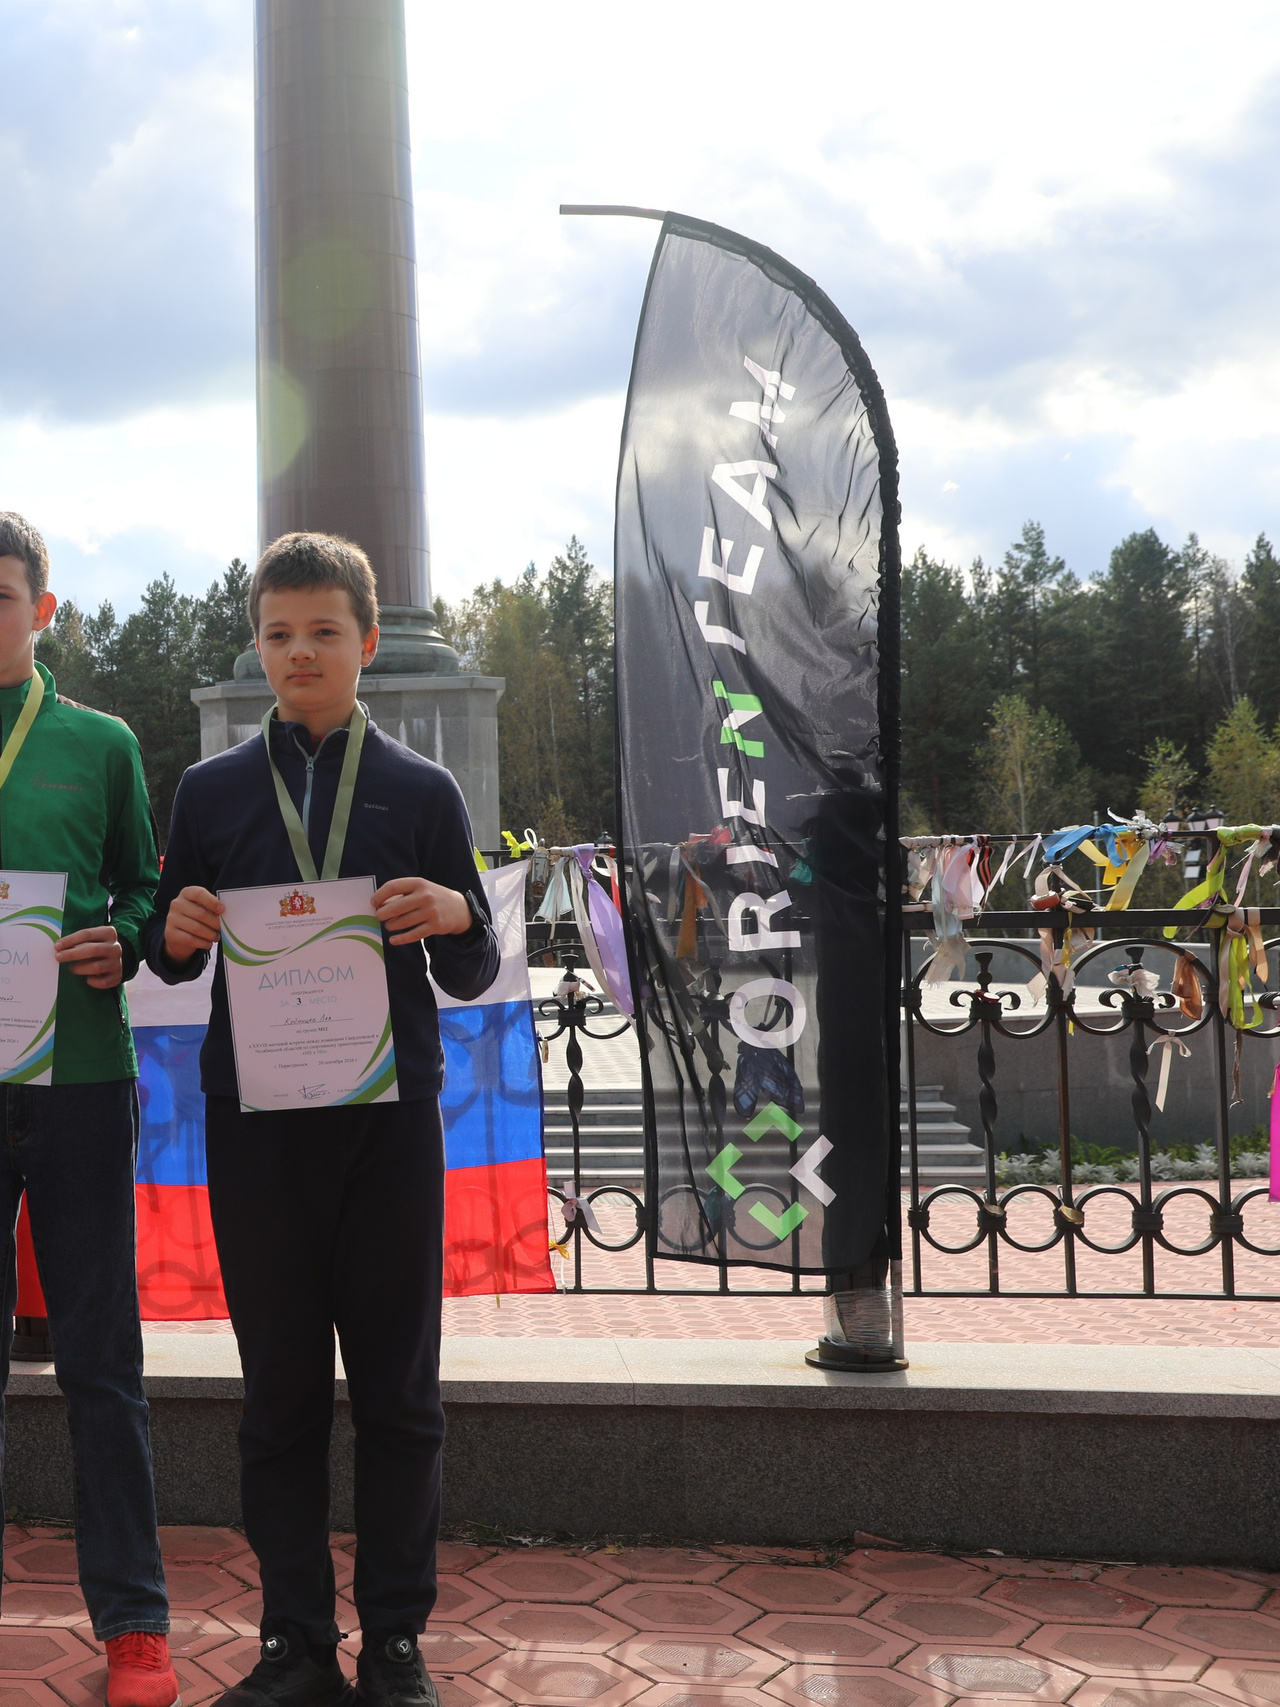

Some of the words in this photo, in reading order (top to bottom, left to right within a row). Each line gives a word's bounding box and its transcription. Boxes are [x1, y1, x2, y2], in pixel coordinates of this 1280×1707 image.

[694, 355, 807, 1049] ORIENTEAM
[258, 964, 355, 991] ДИПЛОМ
[296, 997, 302, 1006] 3
[309, 995, 338, 1005] МЕСТО
